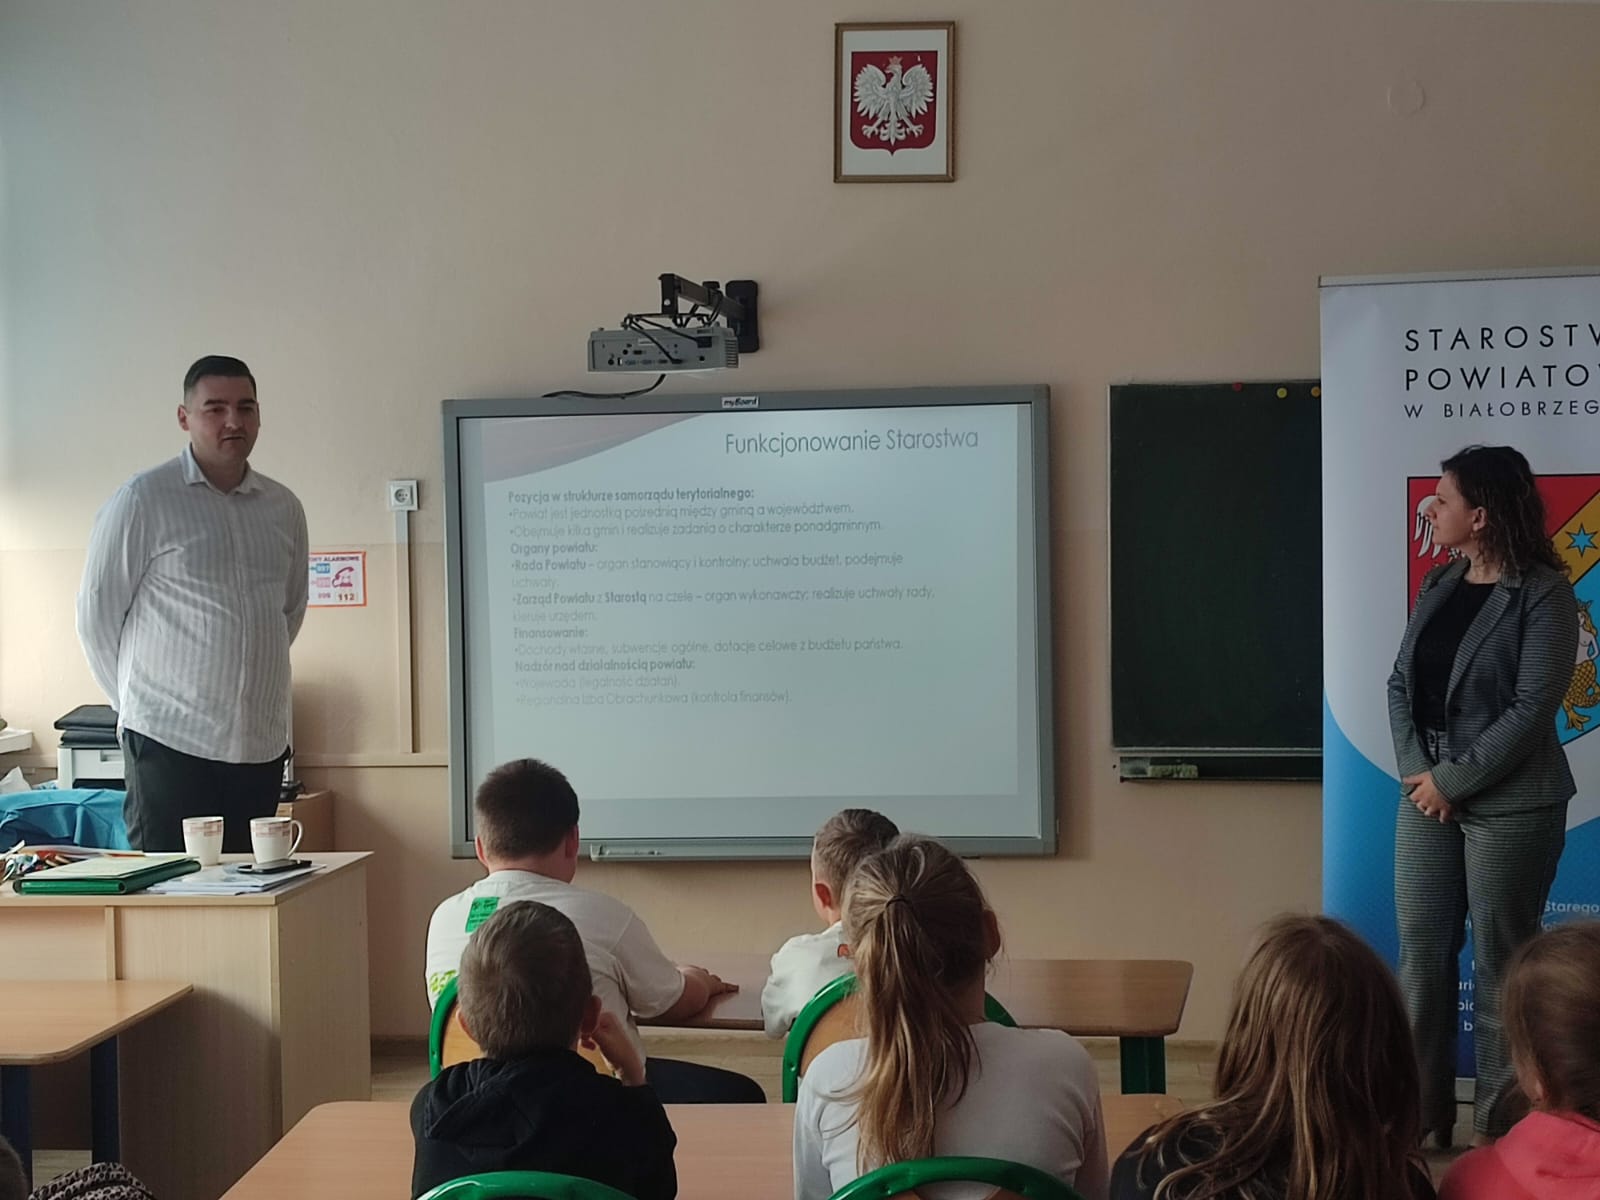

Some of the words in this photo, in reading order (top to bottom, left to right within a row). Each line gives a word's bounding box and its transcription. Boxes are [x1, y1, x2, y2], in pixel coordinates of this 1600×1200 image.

[1405, 363, 1600, 391] POWIATO
[1404, 404, 1423, 418] W
[1444, 399, 1599, 418] BIAŁOBRZEG
[725, 429, 881, 458] Funkcjonowanie
[886, 427, 979, 450] Starostwa
[508, 490, 549, 504] Pozycja
[552, 492, 561, 501] w
[564, 489, 613, 501] strukturze
[615, 488, 673, 503] samorządu
[676, 486, 755, 503] terytorialnego:
[550, 507, 567, 521] jest
[680, 505, 716, 519] między
[720, 504, 754, 518] gminą
[757, 505, 765, 516] a
[767, 501, 854, 517] województwem.
[593, 524, 619, 538] gmin
[627, 522, 670, 537] realizuje
[672, 522, 716, 534] zadania
[718, 523, 726, 533] o
[728, 520, 791, 533] charakterze
[510, 543, 550, 557] Organy
[553, 541, 598, 556] powiatu:
[545, 558, 586, 571] Powiatu
[596, 559, 629, 573] organ
[631, 557, 690, 571] stanowiący
[845, 552, 904, 568] podejmuje
[338, 593, 355, 601] 112
[554, 591, 595, 604] Powiatu
[605, 590, 647, 606] Starostą
[649, 593, 663, 602] na
[665, 590, 693, 603] czele
[705, 590, 737, 604] organ
[812, 586, 855, 602] realizuje
[858, 586, 903, 601] uchwały
[514, 626, 588, 640] Finansowanie:
[612, 640, 667, 655] subwencje
[714, 639, 756, 654] dotacje
[758, 639, 797, 651] celowe
[807, 637, 850, 651] budżetu
[854, 636, 903, 652] państwa.
[515, 659, 552, 672] Nadzór
[554, 659, 576, 671] nad
[578, 658, 648, 673] działalnością
[650, 657, 695, 672] powiatu:
[606, 691, 688, 705] Obrachunkowa
